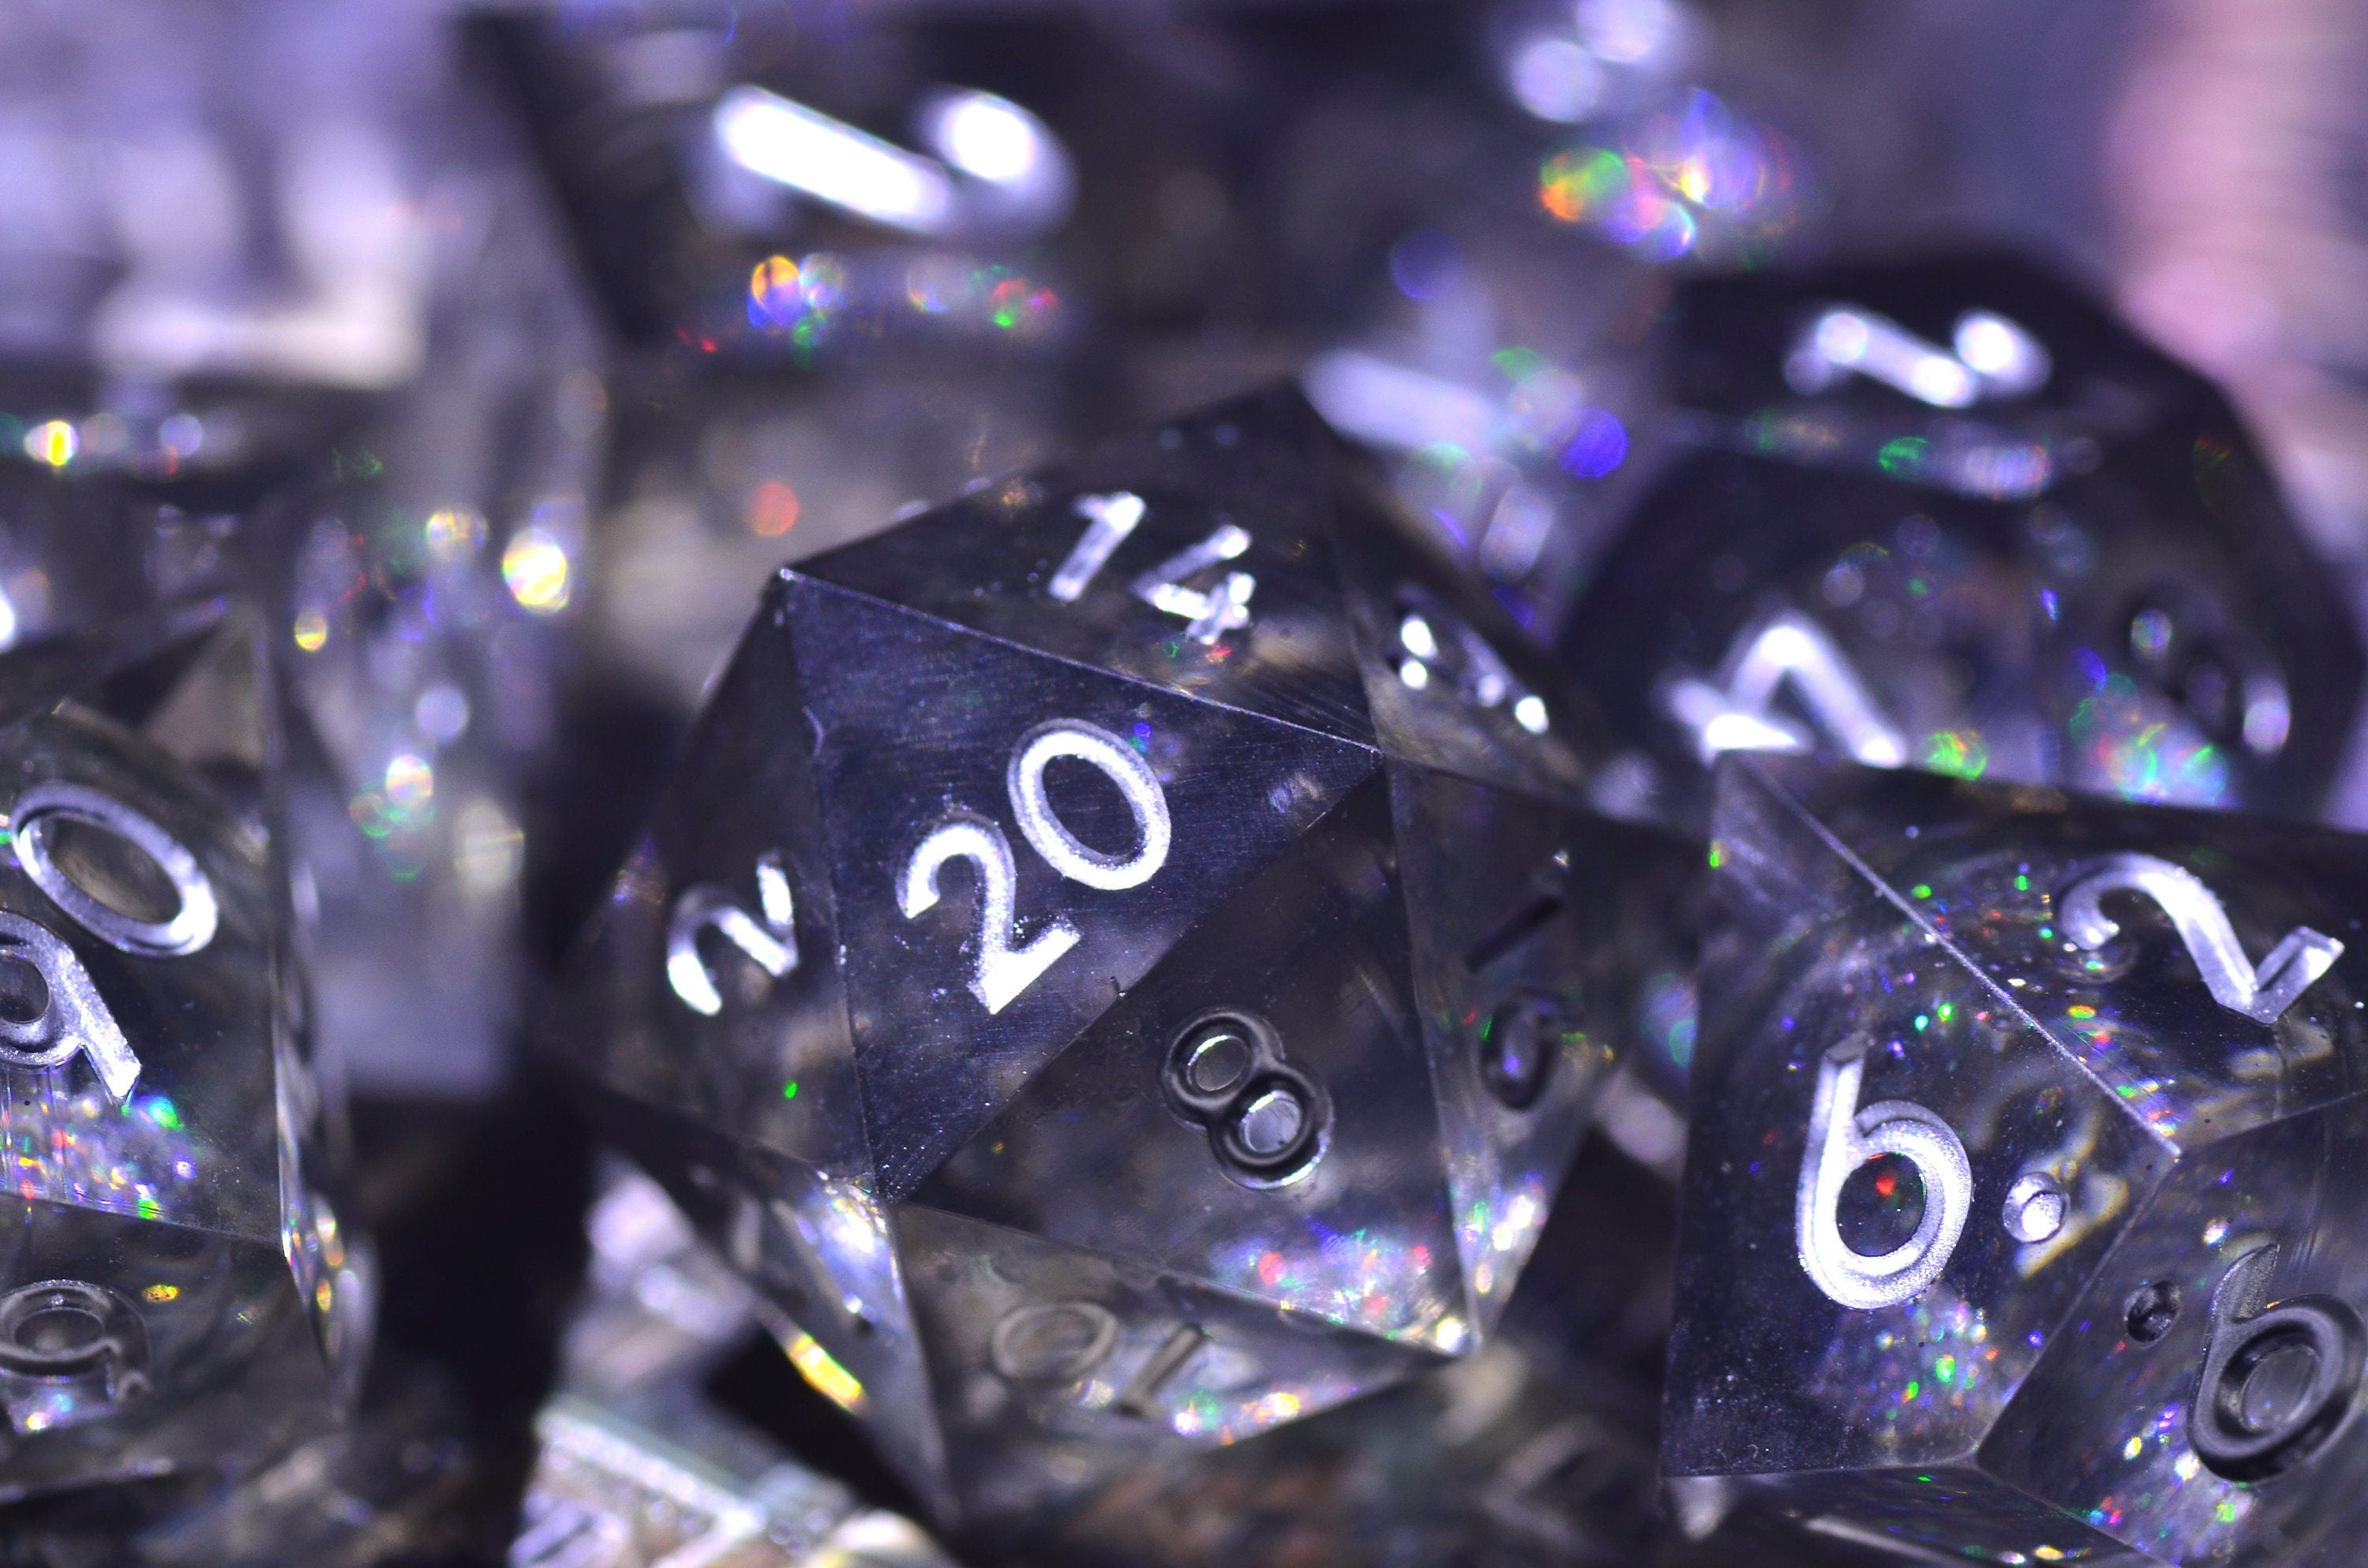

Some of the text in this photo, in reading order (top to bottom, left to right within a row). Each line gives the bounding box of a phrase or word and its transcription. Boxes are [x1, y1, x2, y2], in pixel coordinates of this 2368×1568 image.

[1047, 491, 1255, 646] 14
[667, 854, 799, 1016] 2
[895, 717, 1171, 1015] 20
[2060, 852, 2345, 1024] 2
[1162, 1005, 1336, 1192] 8
